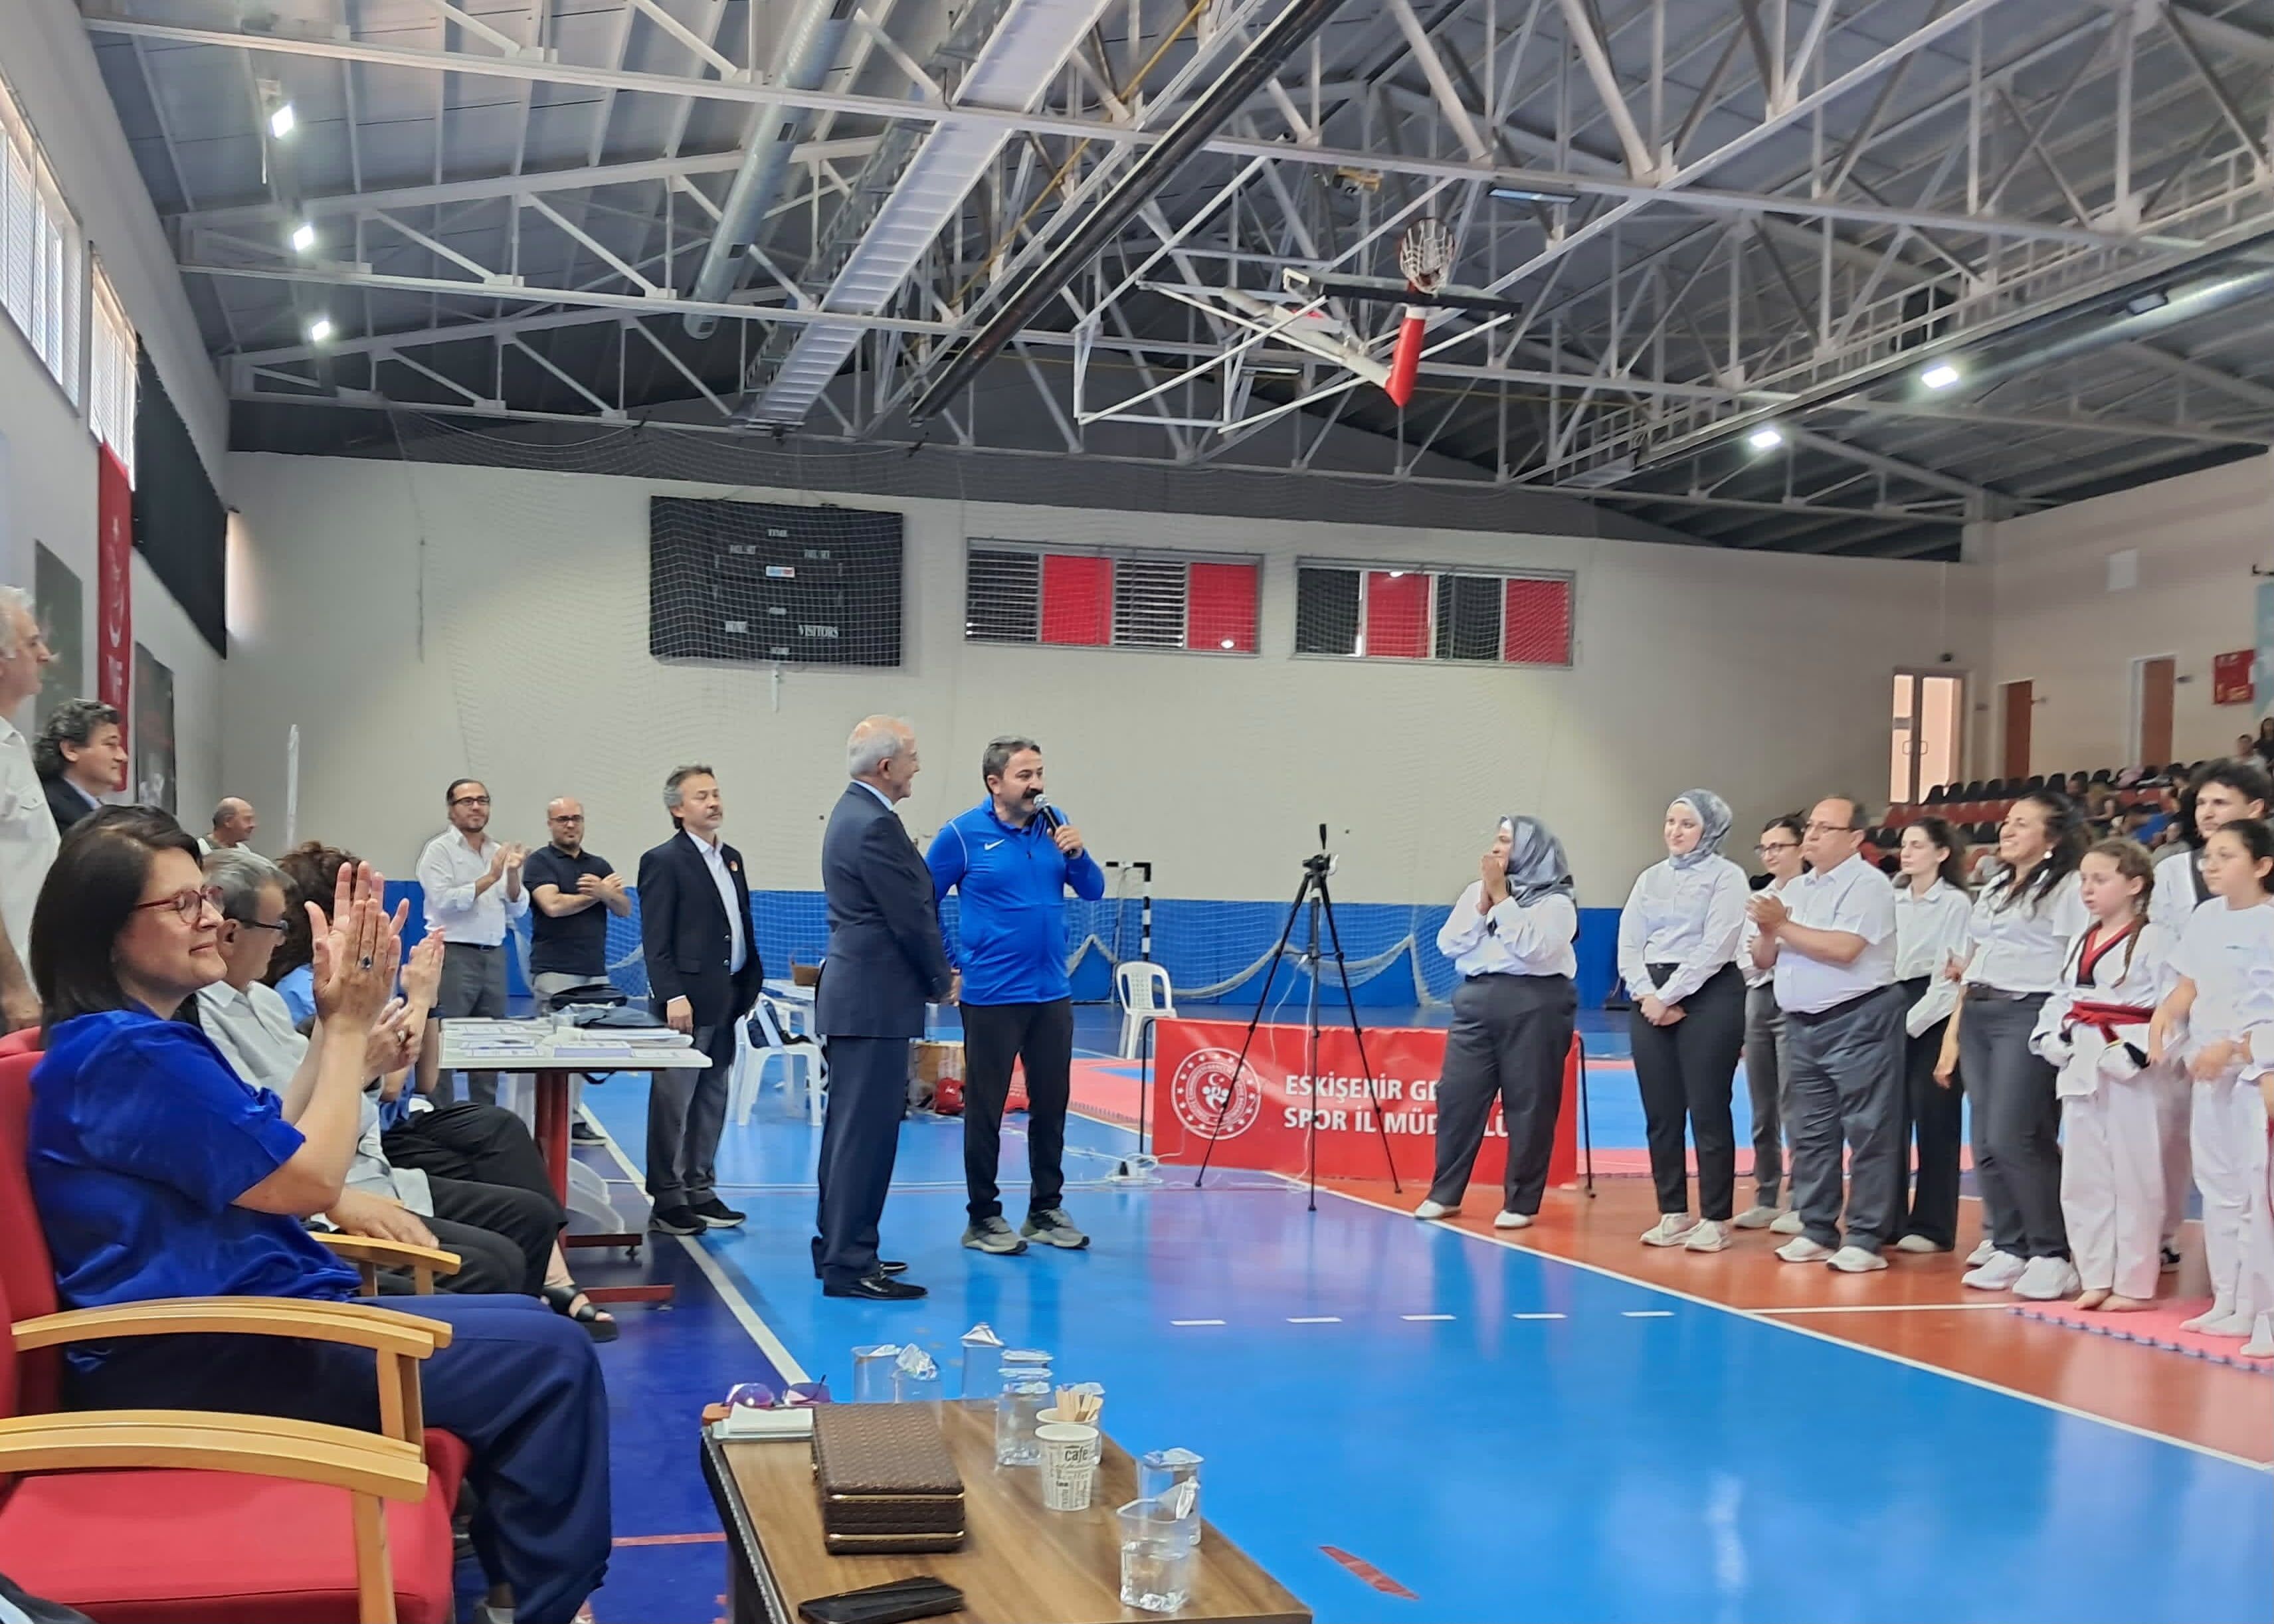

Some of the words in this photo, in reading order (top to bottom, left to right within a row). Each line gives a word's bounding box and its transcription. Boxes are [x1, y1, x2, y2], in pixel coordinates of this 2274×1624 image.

[799, 624, 839, 638] VISITORS
[1285, 1071, 1402, 1103] ESKİŞEHİR
[1283, 1107, 1347, 1131] SPOR
[1355, 1105, 1376, 1132] İL
